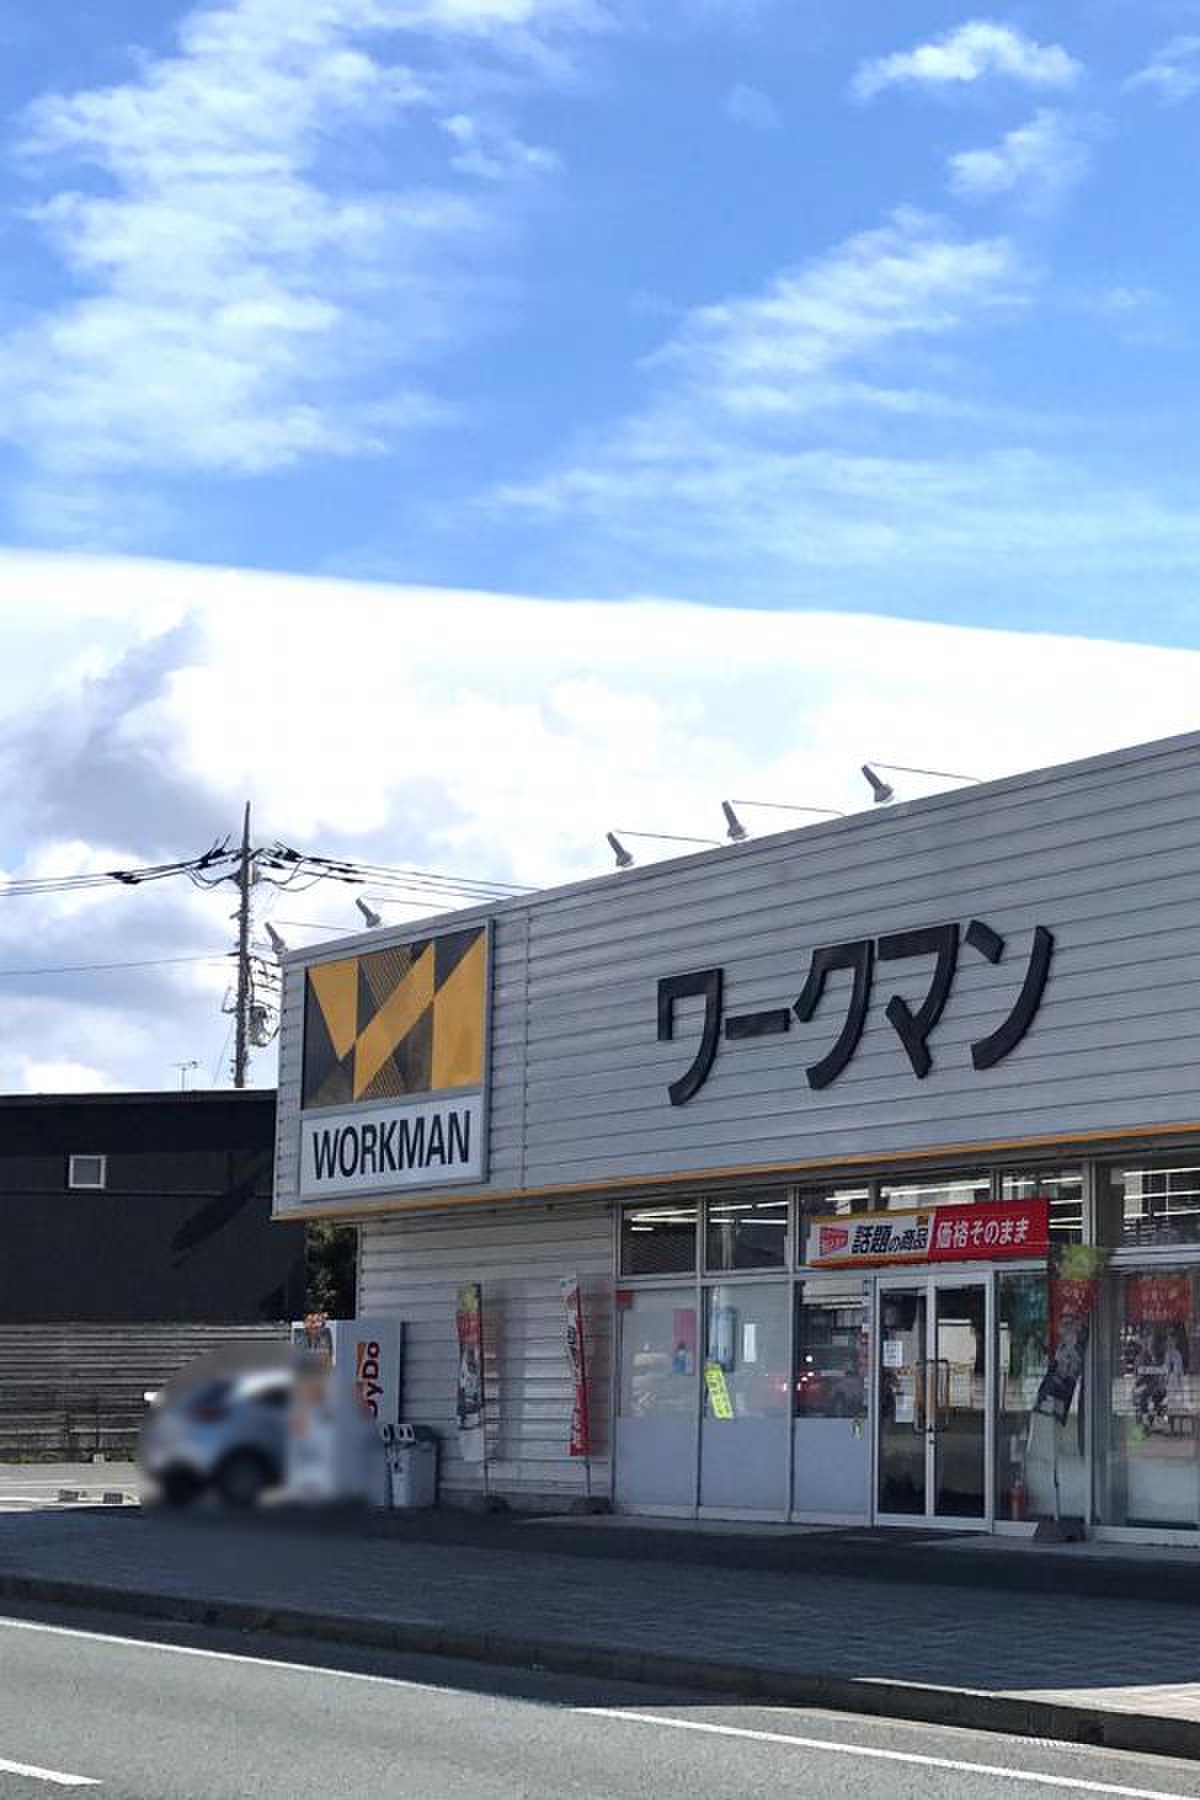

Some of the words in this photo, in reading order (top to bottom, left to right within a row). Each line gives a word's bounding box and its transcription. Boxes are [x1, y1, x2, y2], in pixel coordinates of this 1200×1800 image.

[657, 919, 1054, 1106] ワークマン
[313, 1111, 471, 1180] WORKMAN
[851, 1224, 929, 1254] 話題の商品
[935, 1217, 1030, 1249] 価格そのまま
